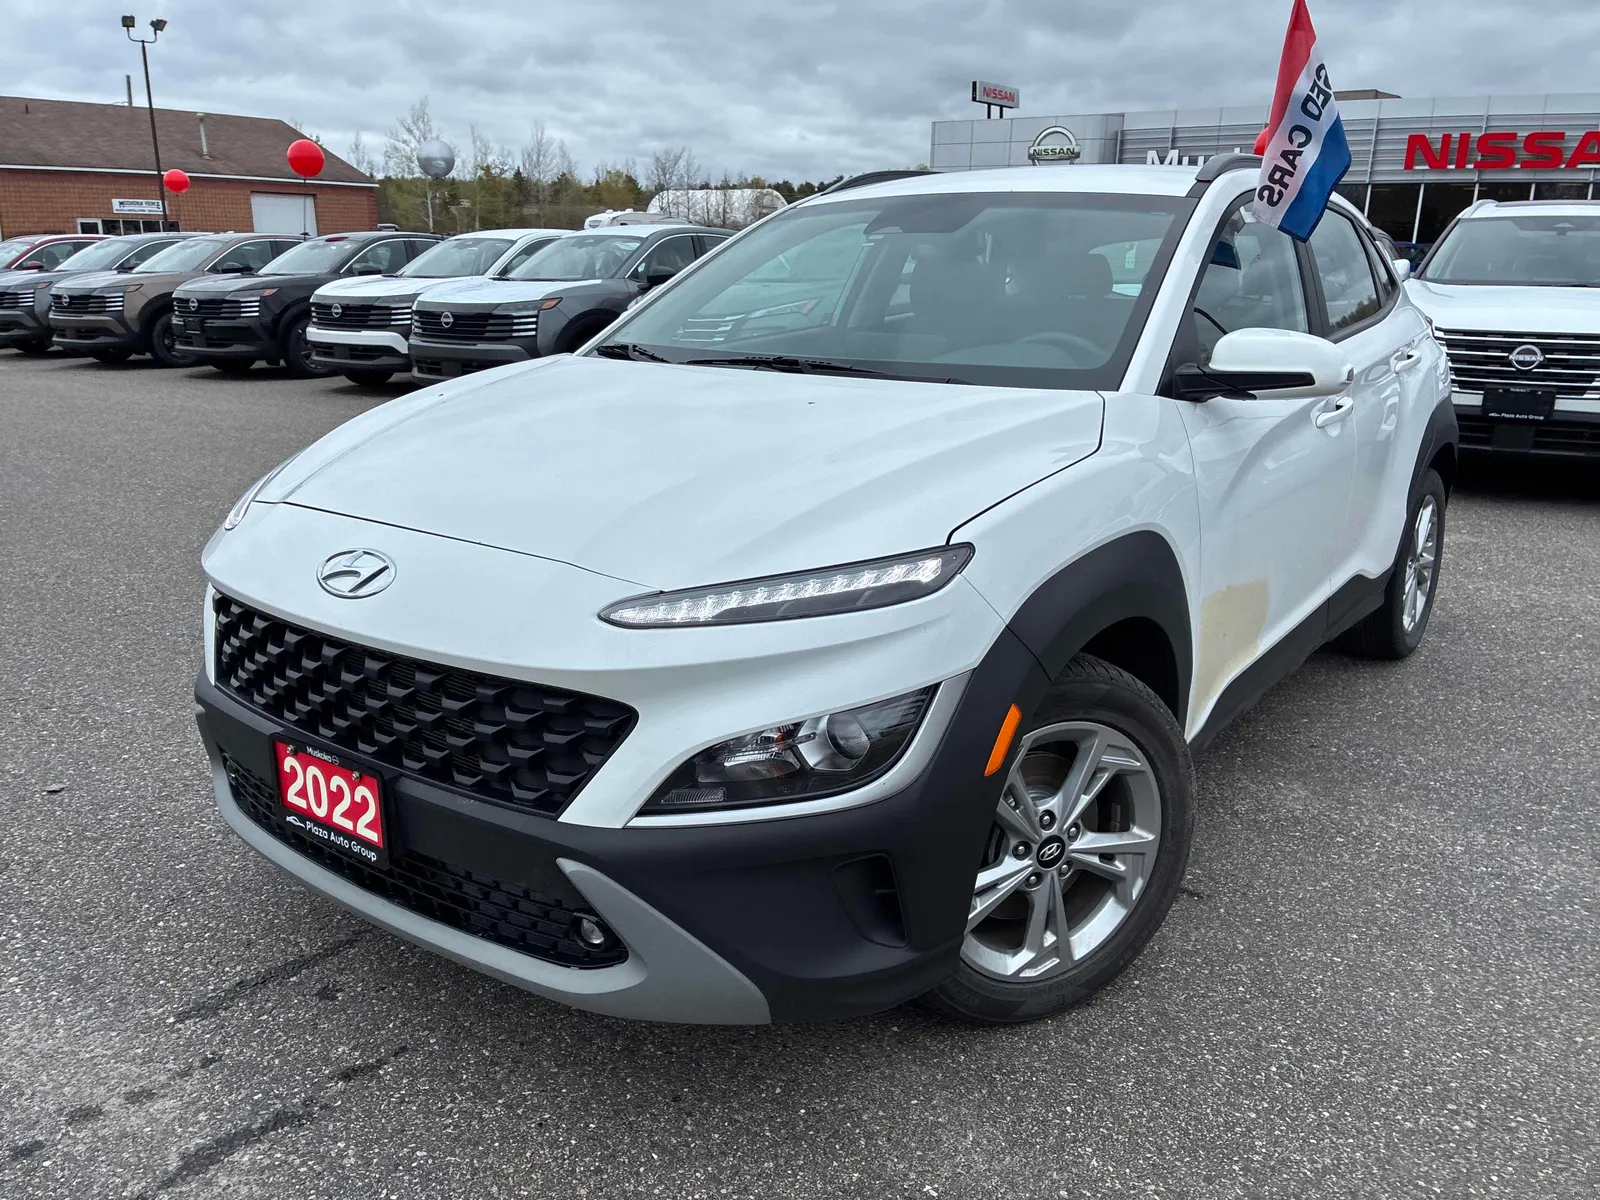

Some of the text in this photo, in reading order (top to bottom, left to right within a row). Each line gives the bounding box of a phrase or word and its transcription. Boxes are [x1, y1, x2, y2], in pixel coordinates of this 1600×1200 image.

[982, 86, 1015, 103] NISSAN
[1032, 147, 1076, 158] NISSAN
[306, 745, 332, 763] Muskoka
[283, 756, 378, 842] 2022
[306, 820, 377, 862] Plaza Auto Group
